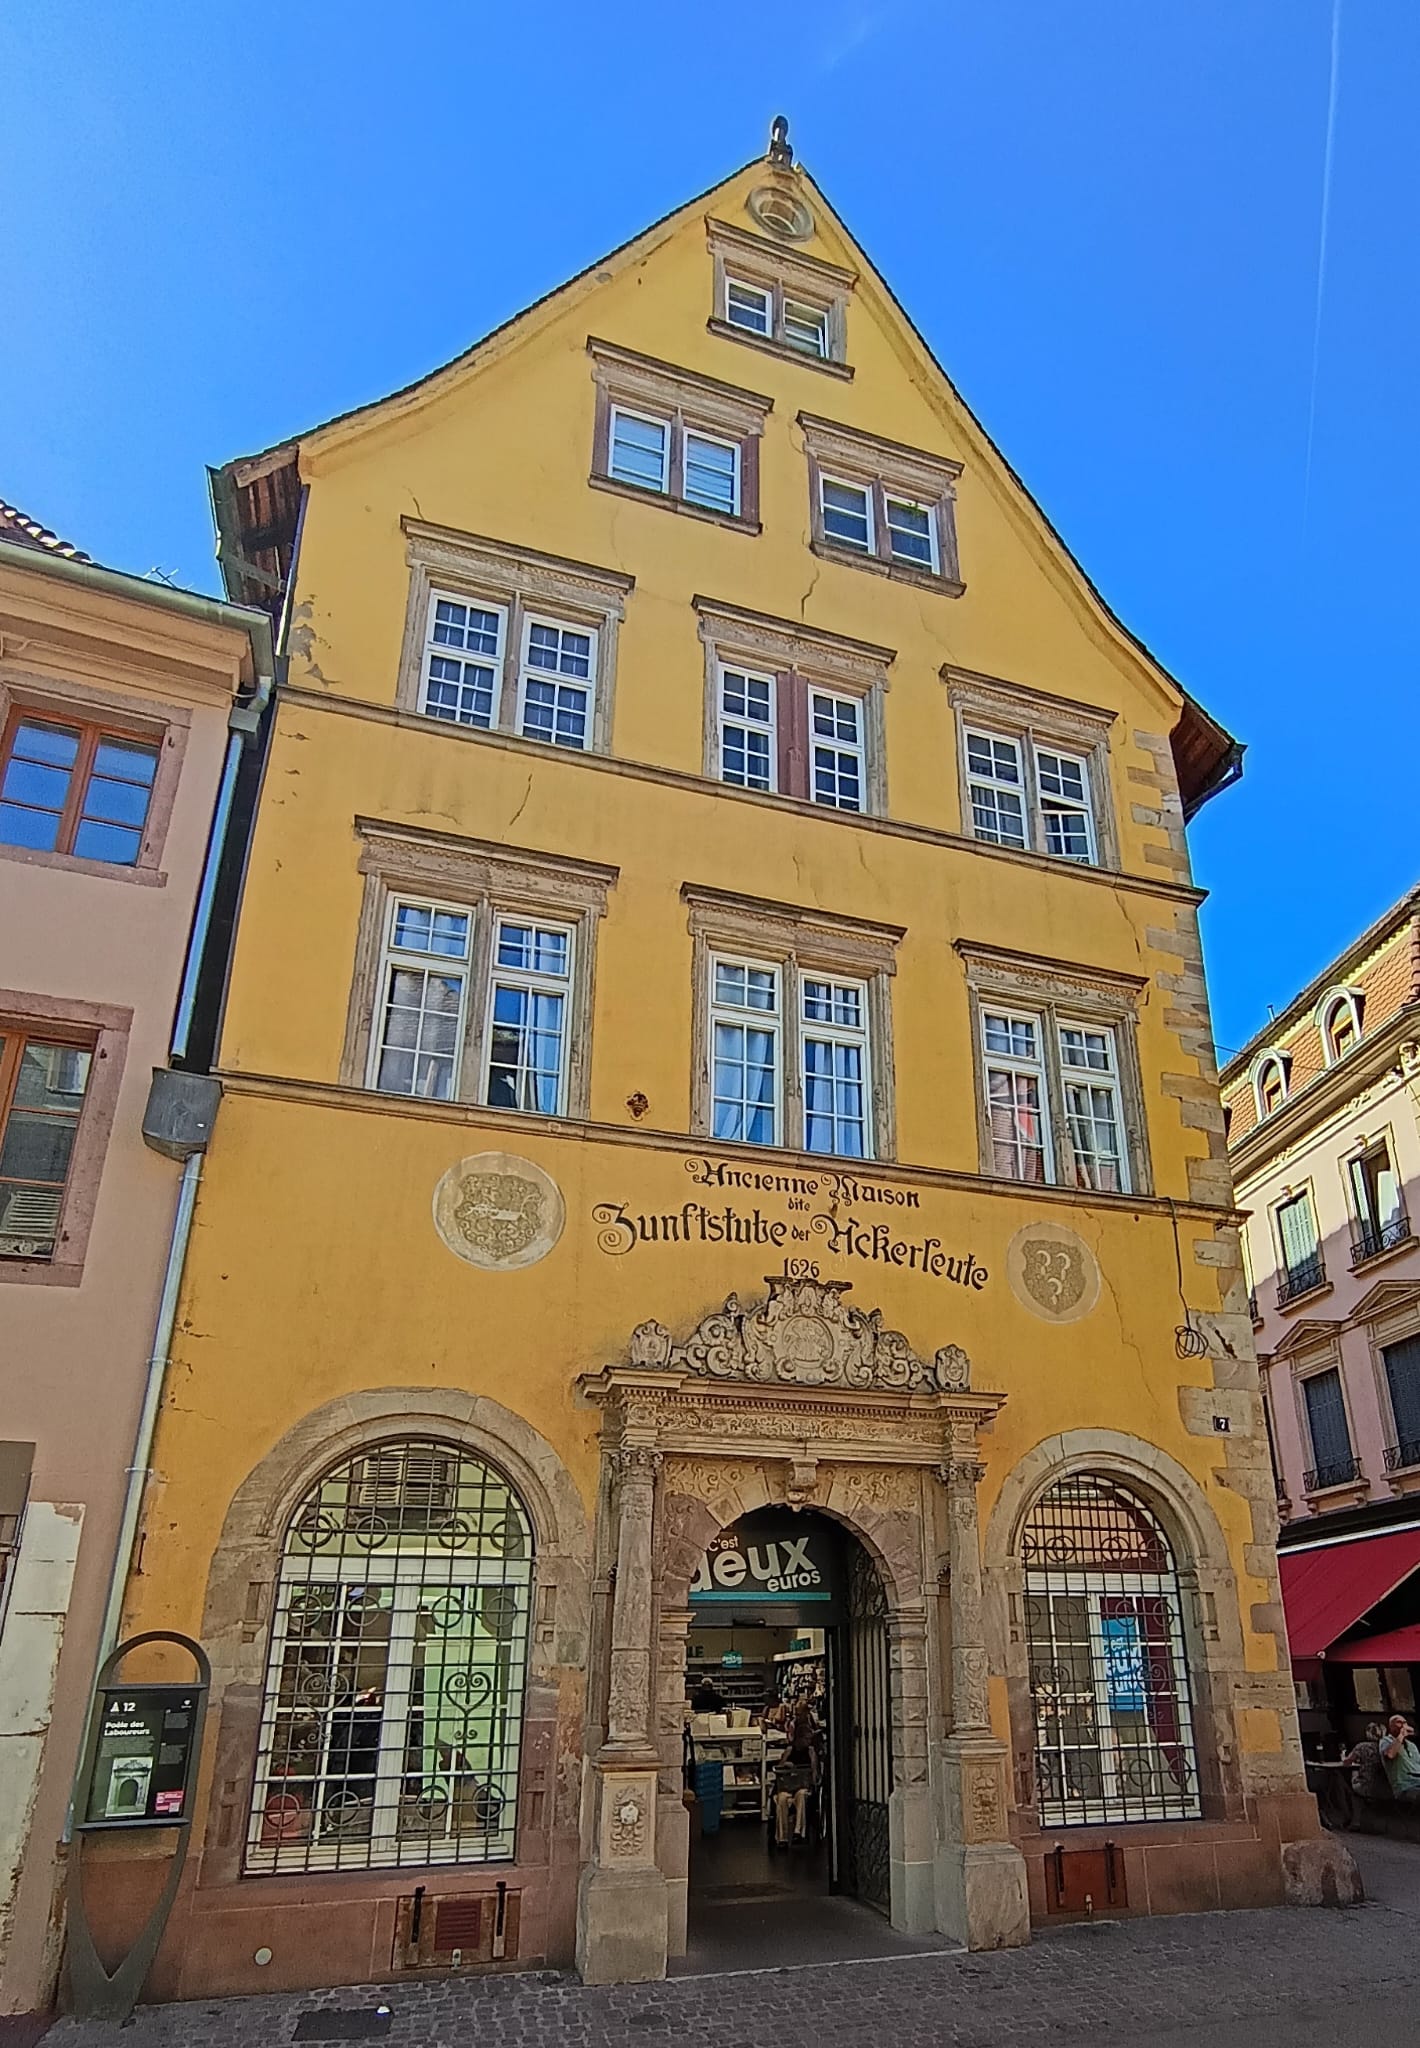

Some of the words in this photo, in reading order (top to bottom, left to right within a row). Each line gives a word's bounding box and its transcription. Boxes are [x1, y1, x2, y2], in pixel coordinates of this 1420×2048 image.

[684, 1158, 819, 1197] Ancienne
[820, 1173, 920, 1209] Maison
[788, 1197, 811, 1211] dite
[592, 1202, 788, 1256] Zunftstube
[792, 1224, 811, 1241] der
[810, 1213, 990, 1290] Ackerleute
[784, 1257, 820, 1278] 1626
[1219, 1418, 1226, 1430] 7
[708, 1535, 739, 1552] C'est
[767, 1570, 821, 1592] euros
[123, 1702, 136, 1712] 12
